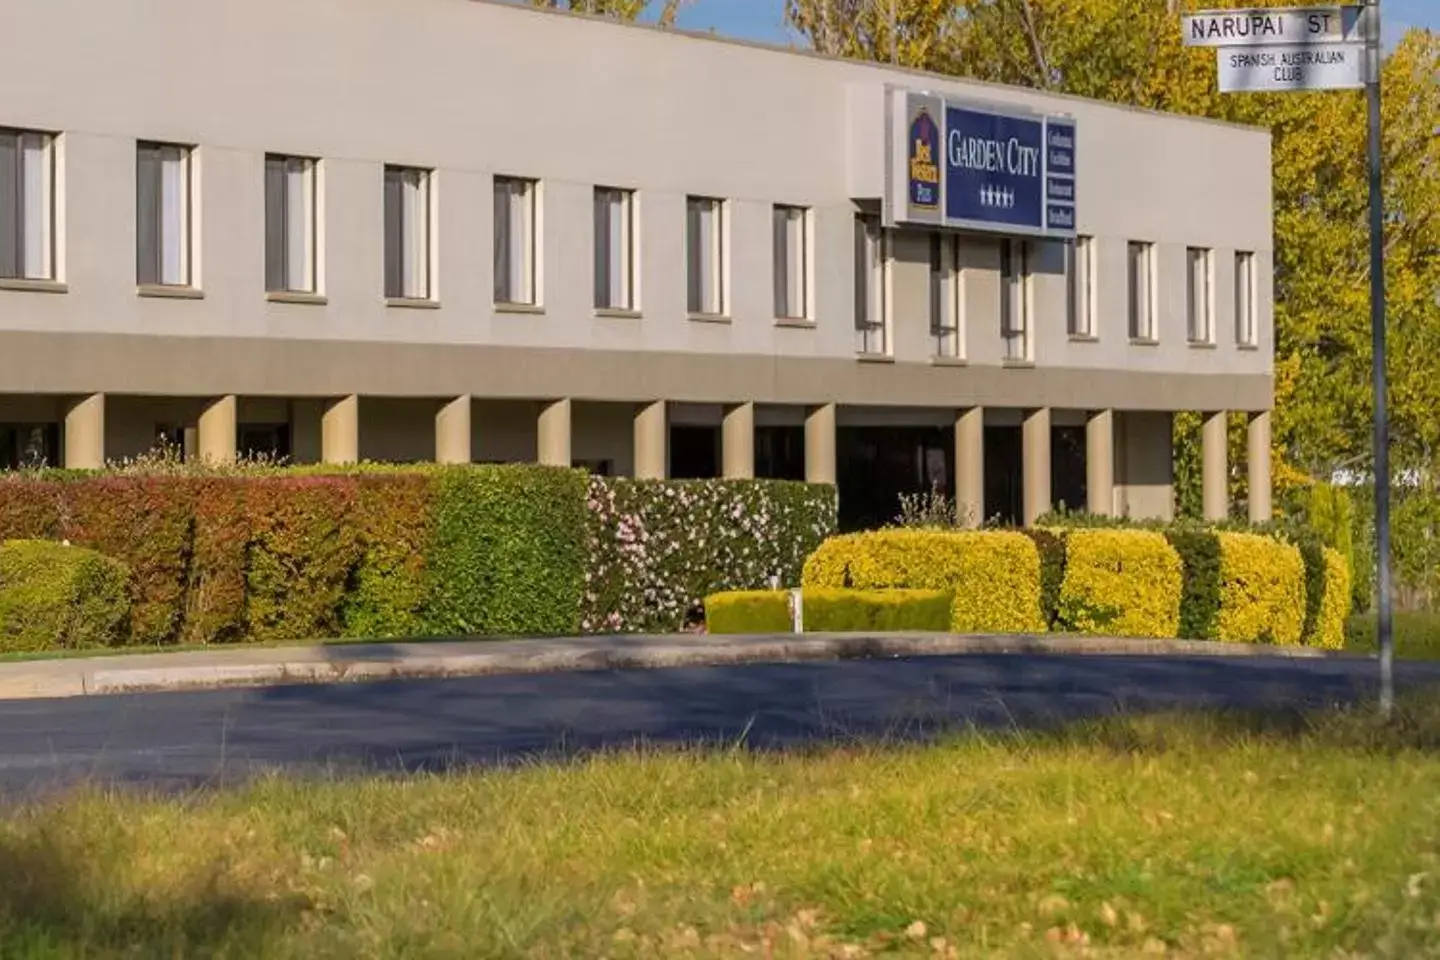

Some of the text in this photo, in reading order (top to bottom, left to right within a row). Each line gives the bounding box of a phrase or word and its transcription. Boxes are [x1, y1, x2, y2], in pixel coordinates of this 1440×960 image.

[1191, 15, 1331, 39] NARUPAI ST
[1230, 50, 1345, 68] SPANISH AUSTRALIAN
[1274, 67, 1303, 82] CLUB
[1007, 138, 1040, 177] CITY
